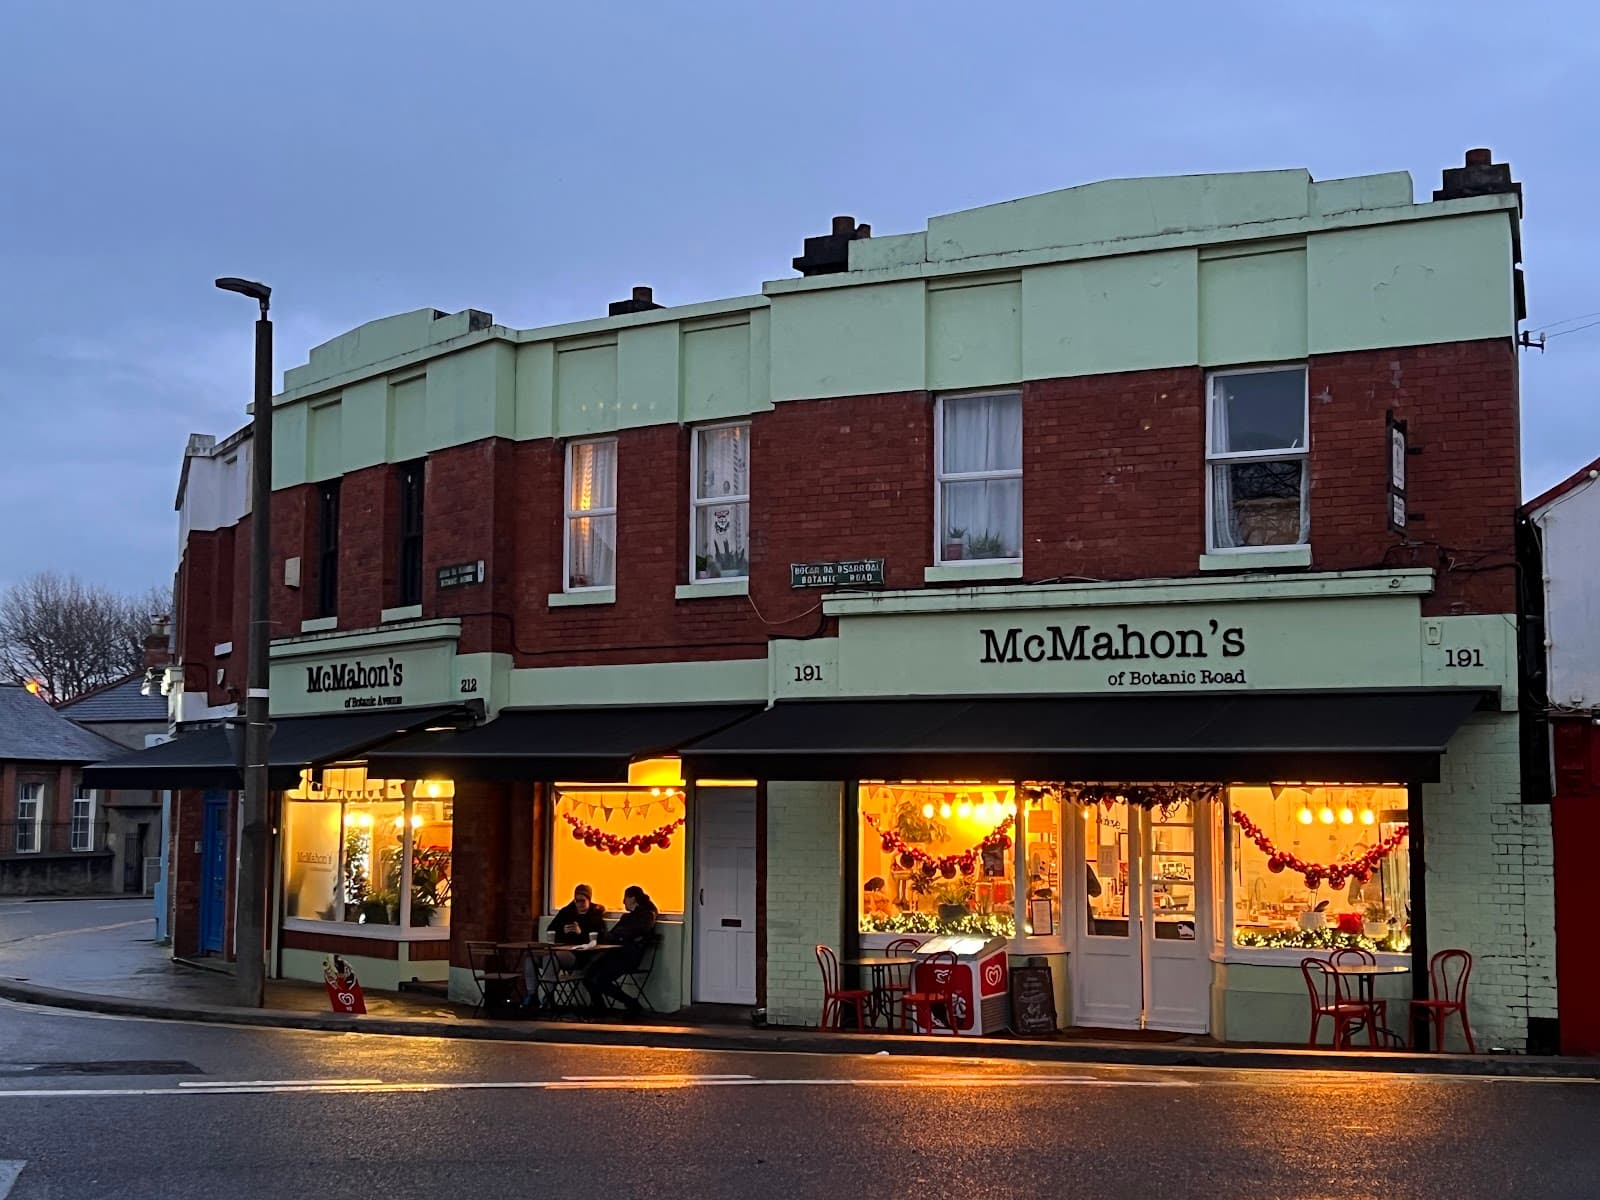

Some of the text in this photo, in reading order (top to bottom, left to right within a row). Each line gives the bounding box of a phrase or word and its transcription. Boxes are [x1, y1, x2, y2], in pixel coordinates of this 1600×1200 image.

[801, 573, 873, 584] BOTANIC ROAD
[980, 619, 1246, 663] McMahon's
[1445, 649, 1484, 667] 191
[306, 657, 403, 693] McMahon's
[794, 665, 823, 682] 191
[1108, 669, 1247, 686] of Botanic Road
[460, 678, 477, 693] 212
[351, 695, 376, 708] Botanic
[377, 695, 403, 706] Avenue
